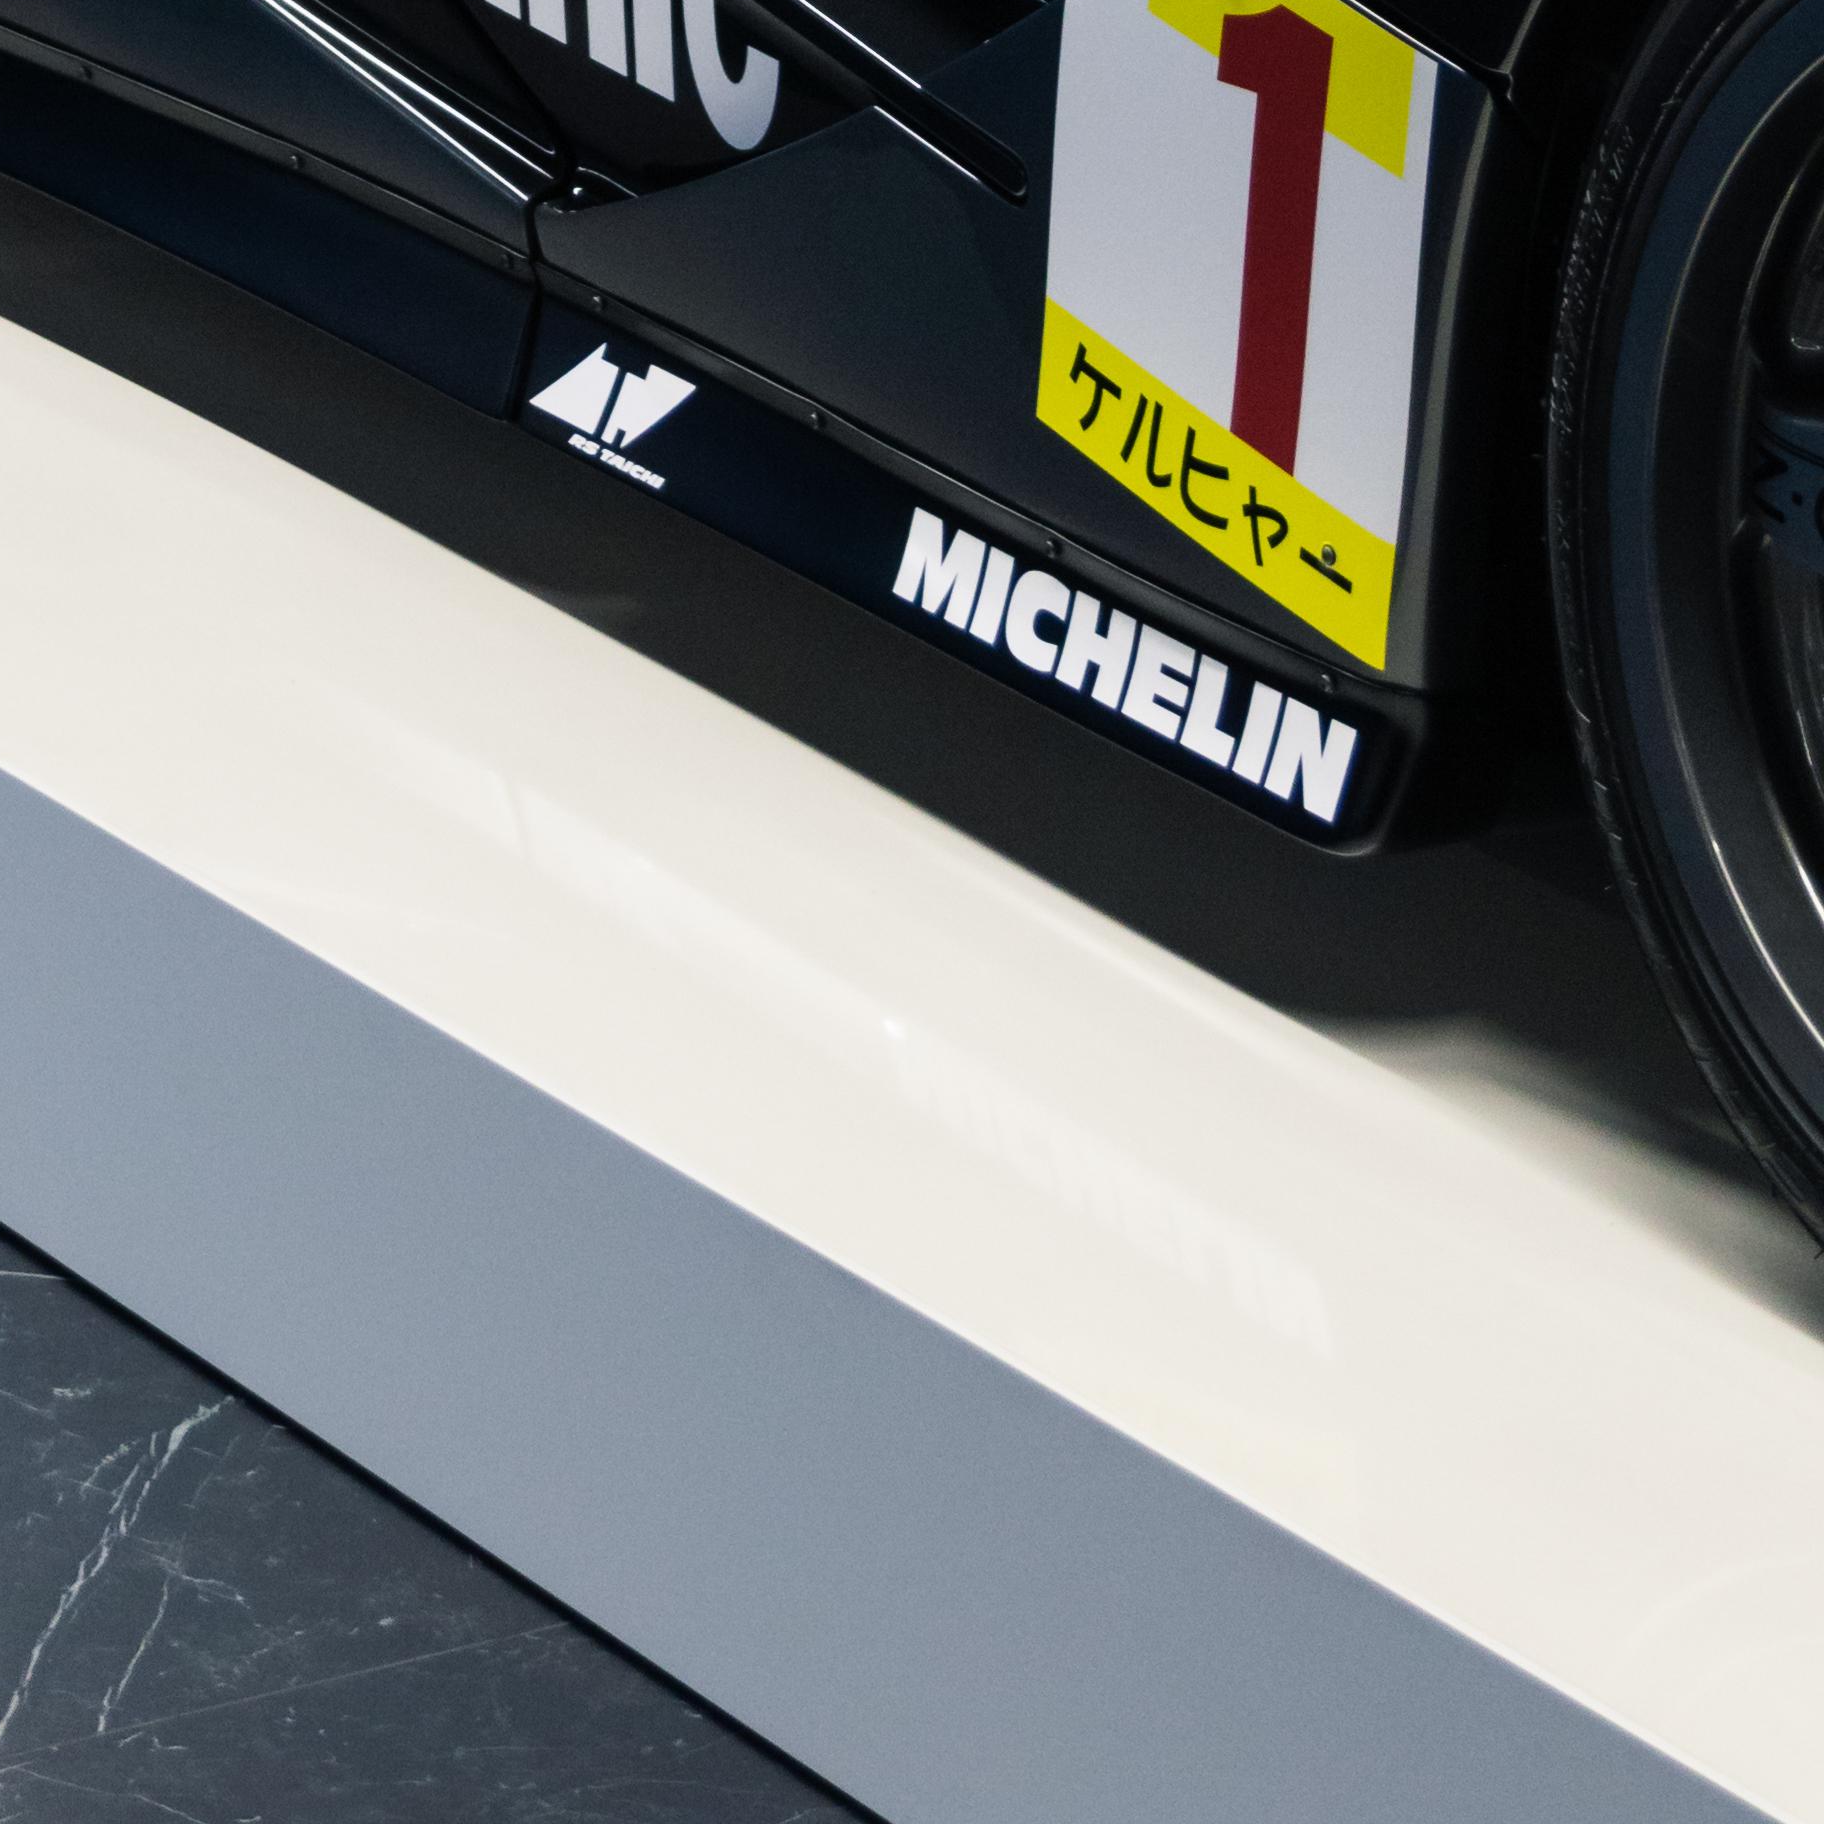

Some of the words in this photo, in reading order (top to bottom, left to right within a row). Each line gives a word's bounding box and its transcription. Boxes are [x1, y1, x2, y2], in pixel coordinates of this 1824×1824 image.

[1217, 4, 1334, 476] 1
[567, 433, 601, 456] RS
[599, 448, 667, 490] TAICHI
[1069, 341, 1354, 595] ケルヒャー
[892, 506, 1358, 824] MICHELIN
